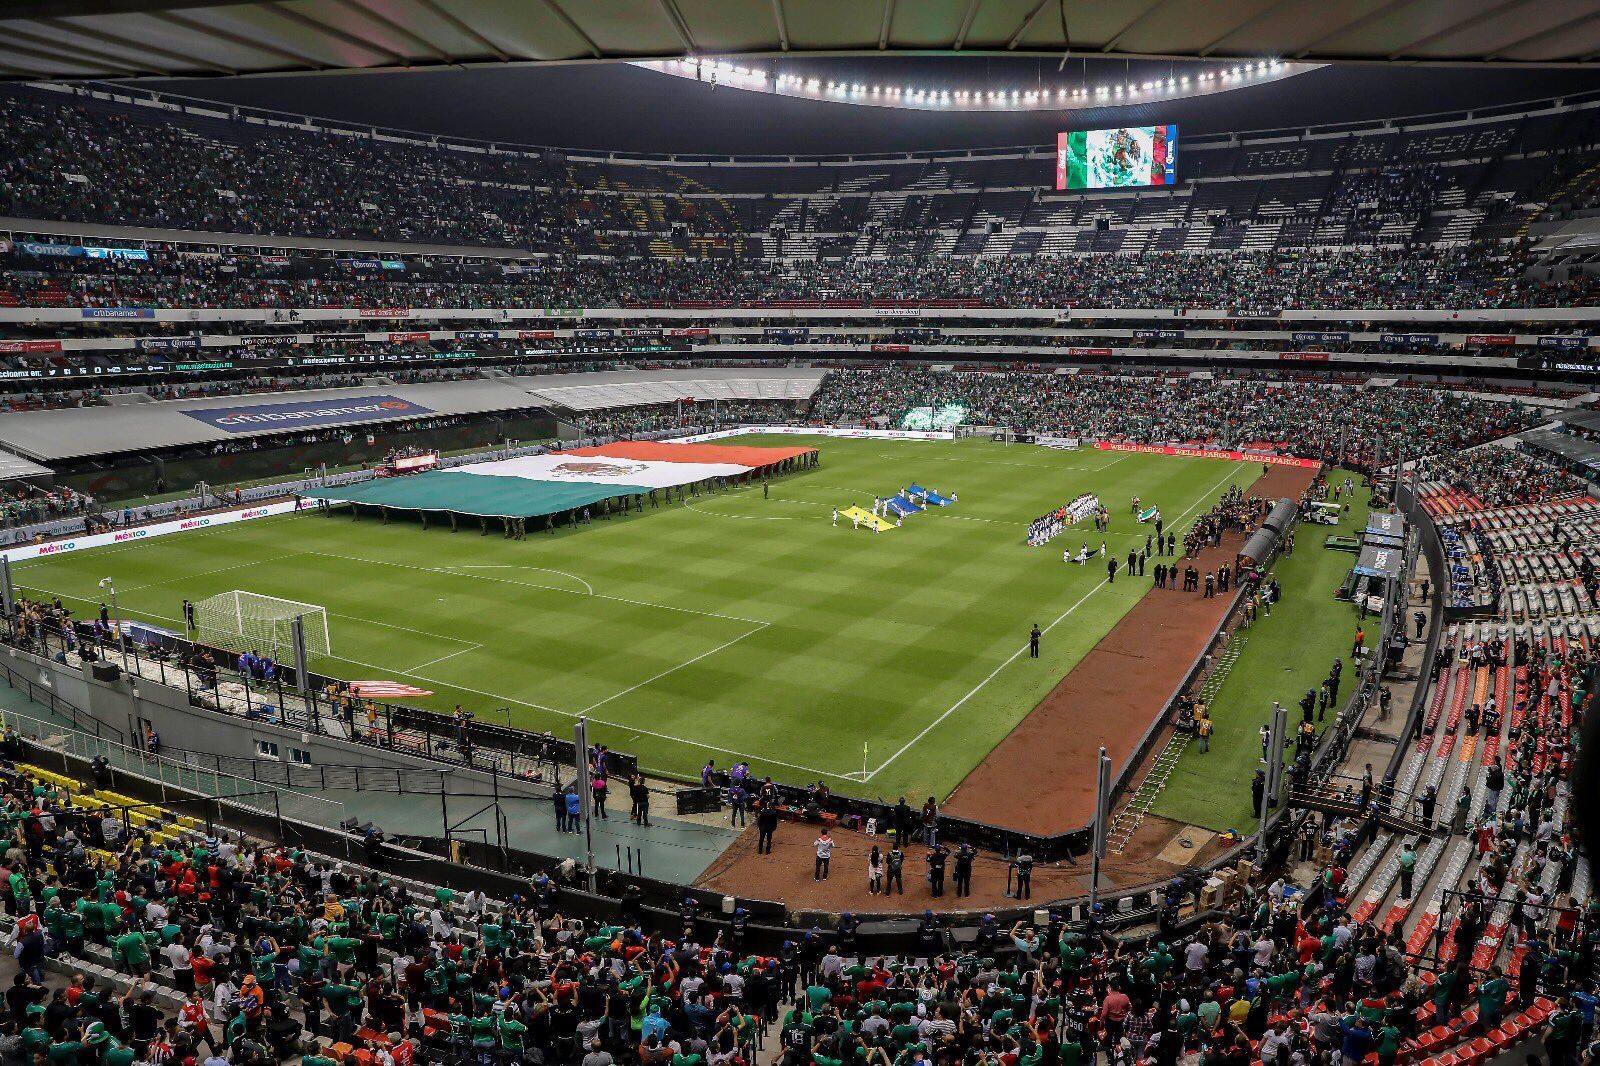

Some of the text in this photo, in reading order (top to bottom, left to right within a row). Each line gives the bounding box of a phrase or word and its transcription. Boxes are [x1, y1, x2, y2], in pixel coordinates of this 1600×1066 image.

[24, 243, 71, 256] Comex
[1321, 333, 1343, 341] Corona
[142, 339, 196, 348] Corona Corona
[215, 403, 389, 425] citibanamex
[1110, 443, 1137, 452] WELLS
[1138, 445, 1164, 454] FARGO
[1174, 448, 1231, 459] WELLS FARGO
[1242, 453, 1271, 463] WELLS
[1272, 457, 1301, 466] FARGO
